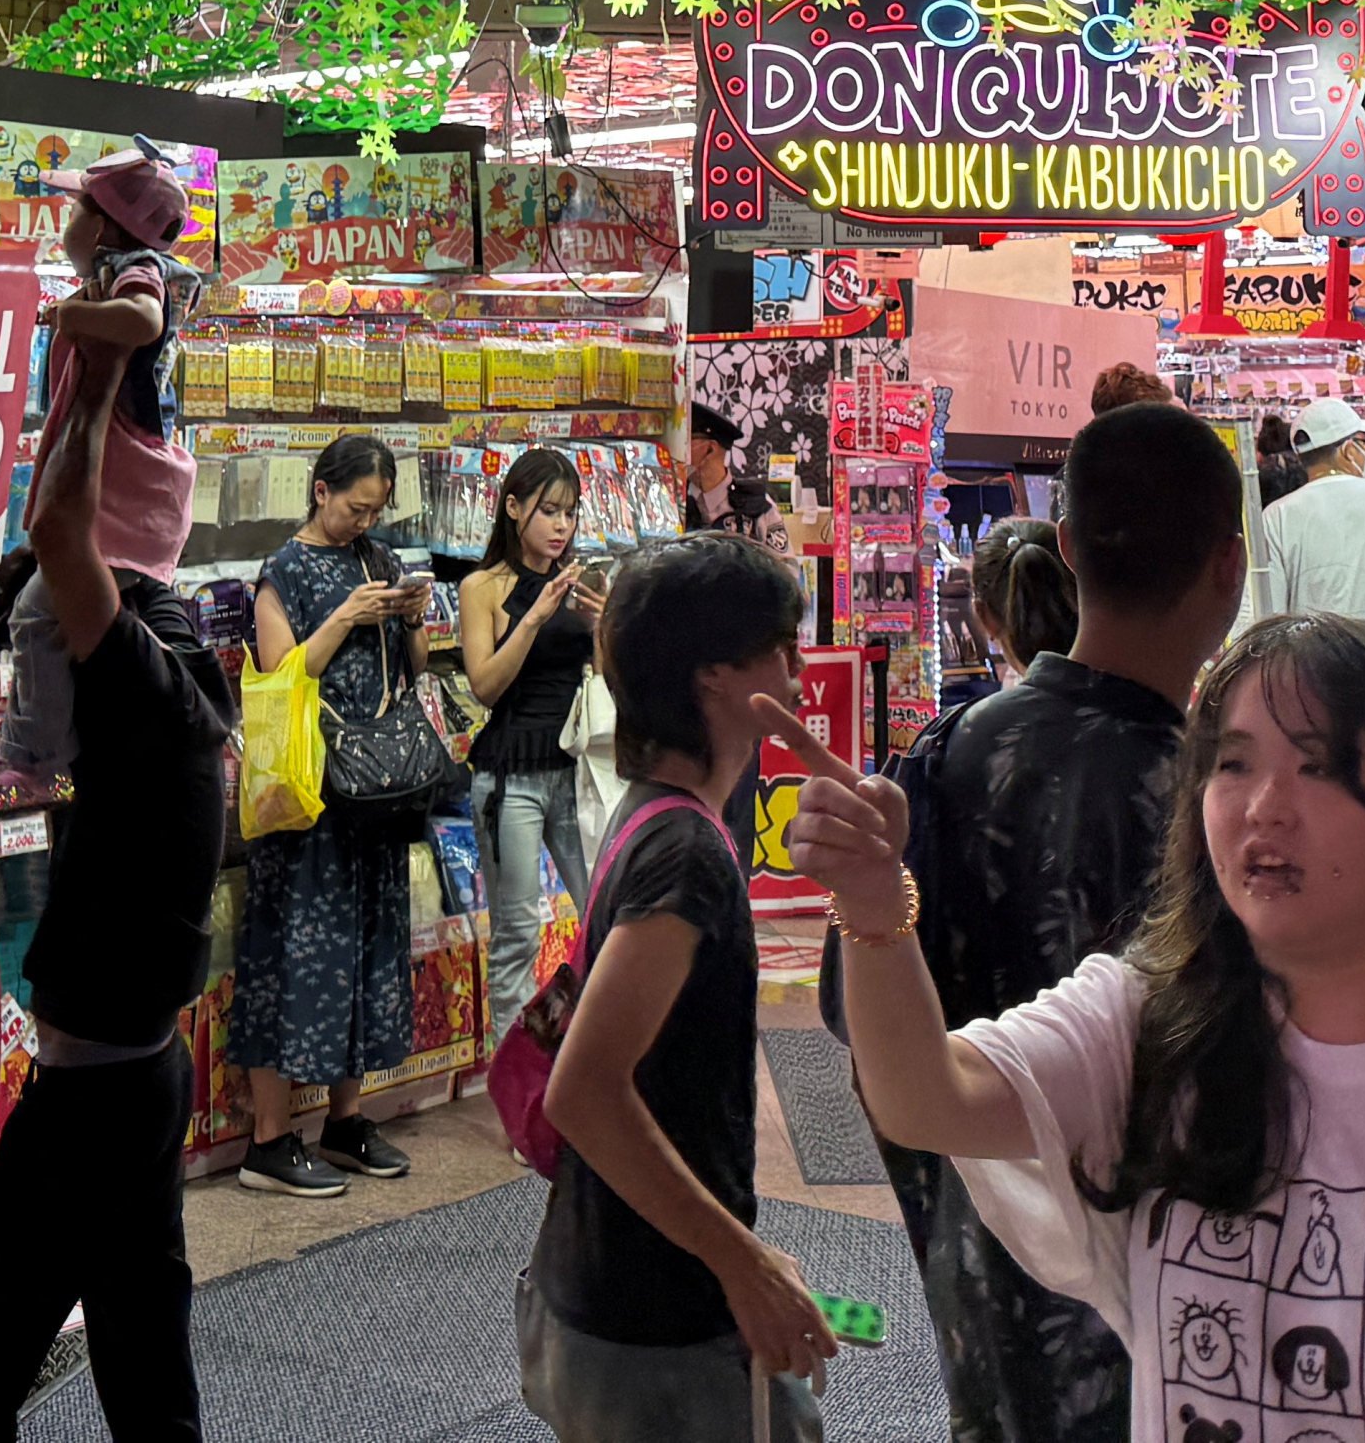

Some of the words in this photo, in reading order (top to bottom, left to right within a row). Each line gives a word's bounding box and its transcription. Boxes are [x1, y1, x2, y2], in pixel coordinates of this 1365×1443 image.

[746, 41, 940, 138] DON
[951, 41, 1326, 143] QUIJOTE
[813, 139, 1267, 212] SHINJUKU-KABUKICHO
[307, 222, 407, 266] JAPAN
[548, 225, 628, 258] JAPAN
[1008, 338, 1072, 390] VIR
[1011, 400, 1068, 419] TOKYO
[291, 429, 332, 444] elcome
